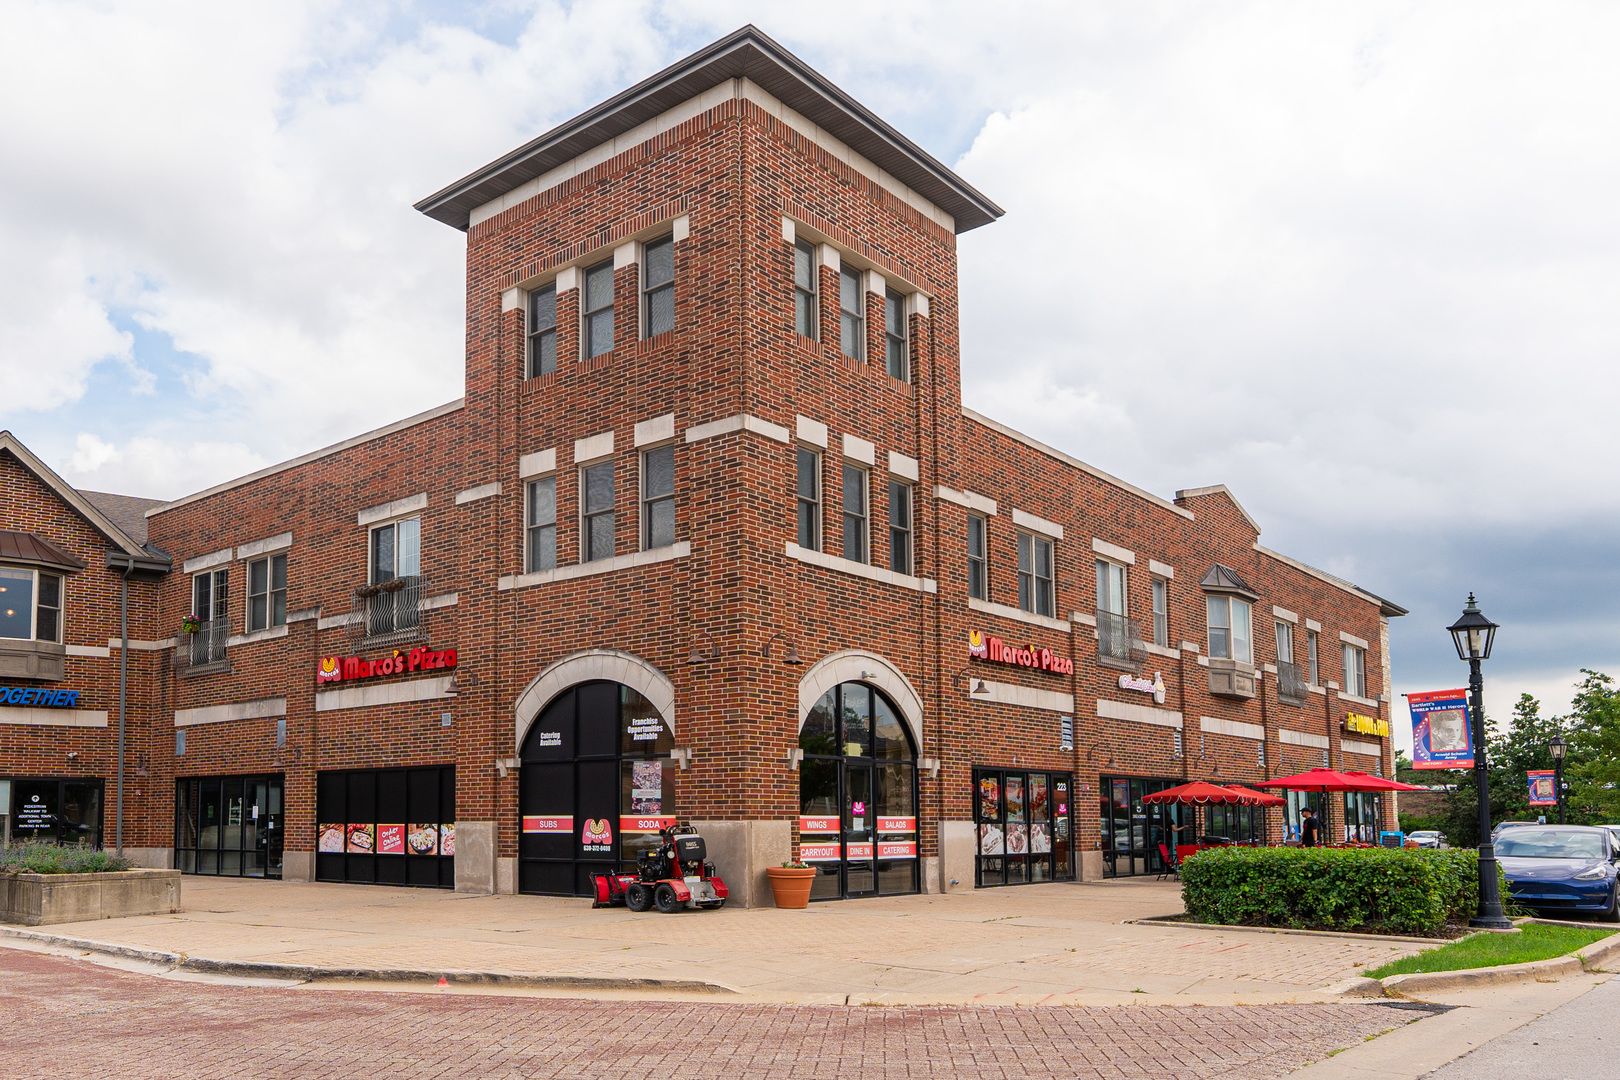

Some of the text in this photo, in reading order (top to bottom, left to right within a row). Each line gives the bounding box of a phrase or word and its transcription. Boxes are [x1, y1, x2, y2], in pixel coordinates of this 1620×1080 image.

[990, 637, 1073, 675] Marco's Pizza
[344, 645, 457, 680] Marco's Pizza
[632, 717, 658, 726] Franchise
[627, 725, 663, 734] Opportunities
[540, 732, 560, 740] Catering
[633, 732, 658, 740] Available
[1057, 782, 1067, 791] 223
[539, 820, 558, 828] SUBS
[638, 820, 660, 828] SODA
[806, 820, 827, 829] WINGS
[885, 820, 907, 829] SALADS
[800, 848, 834, 857] CARRYOUT
[850, 847, 870, 855] DINE IN
[883, 846, 909, 855] CATERING
